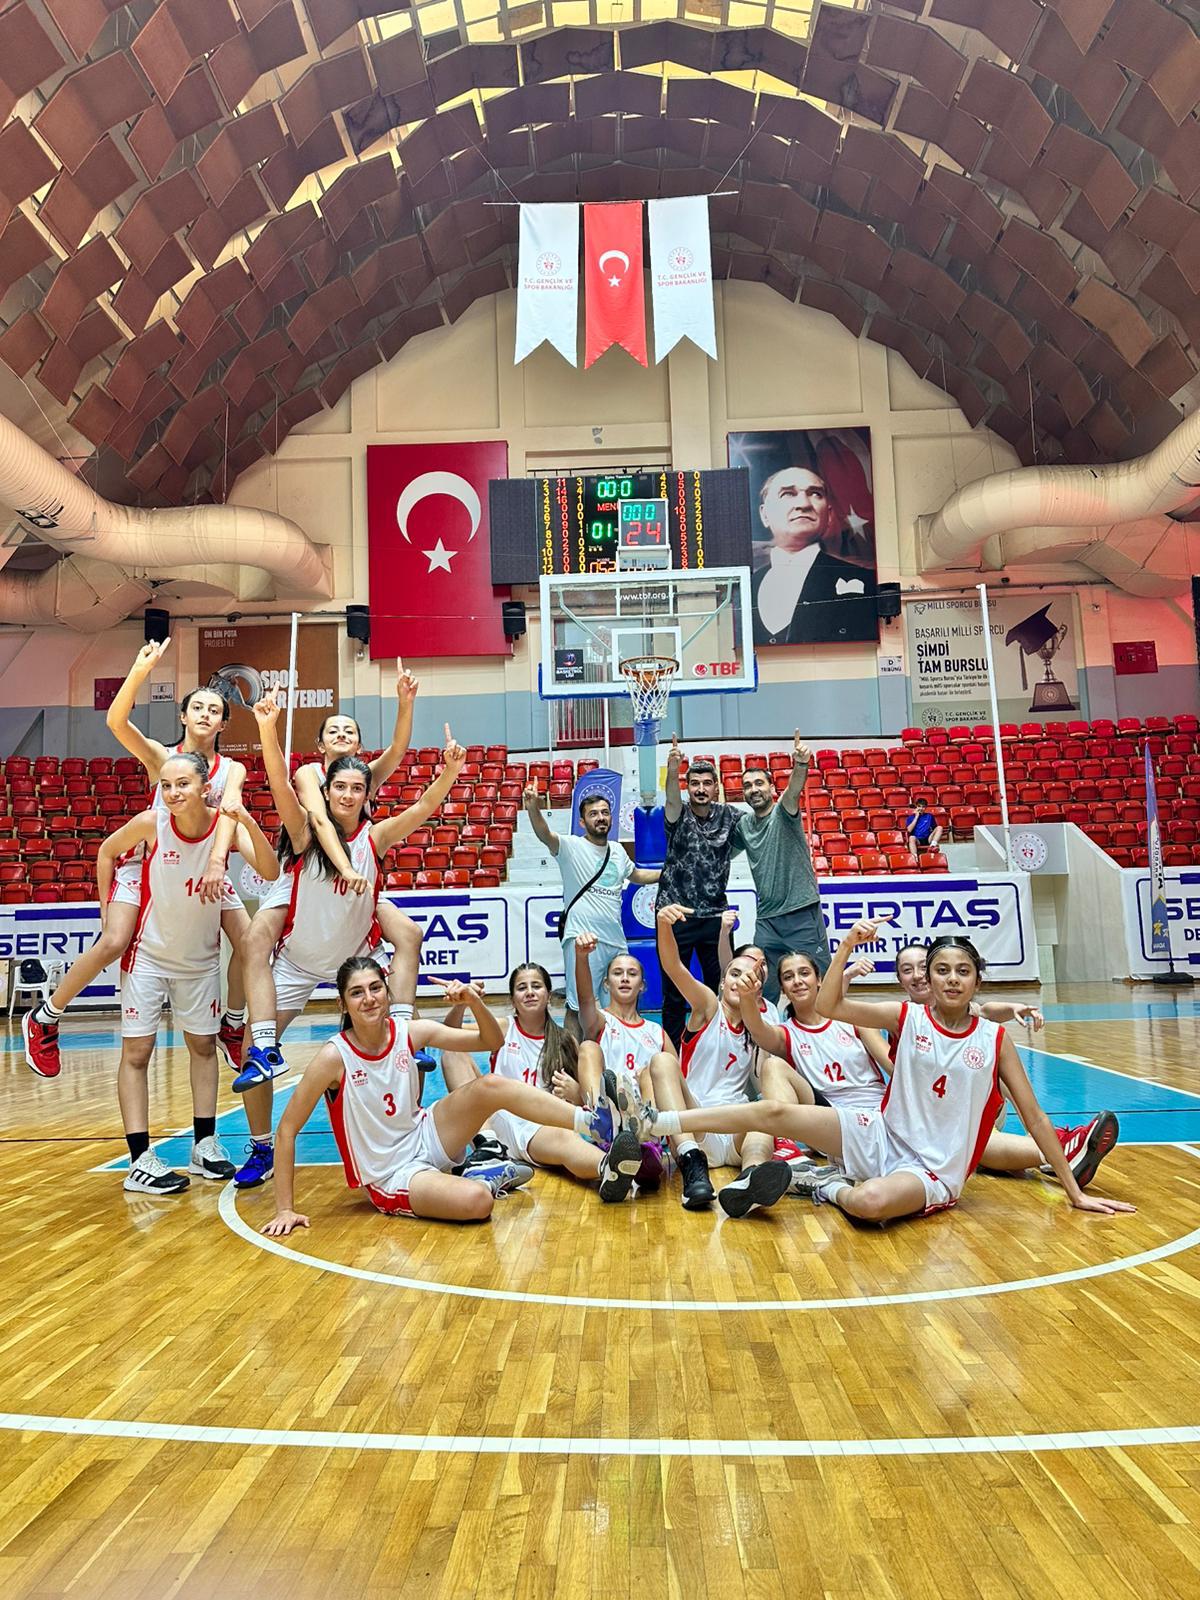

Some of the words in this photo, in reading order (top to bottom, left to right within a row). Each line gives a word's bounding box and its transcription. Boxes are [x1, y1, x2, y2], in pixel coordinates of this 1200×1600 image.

[626, 522, 661, 545] 24
[946, 600, 973, 609] SPORCU
[224, 630, 238, 638] POTA
[915, 628, 950, 640] BAŞARILI
[952, 624, 972, 637] MİLLİ
[974, 624, 1004, 636] SPRCU
[916, 640, 949, 661] ŞİMDİ
[709, 662, 740, 676] TBF
[918, 660, 942, 673] TAM
[626, 1053, 635, 1070] 8
[725, 1052, 737, 1071] 7
[522, 1068, 537, 1086] 11
[824, 1061, 846, 1082] 12
[932, 1074, 947, 1098] 4
[383, 1093, 396, 1116] 3
